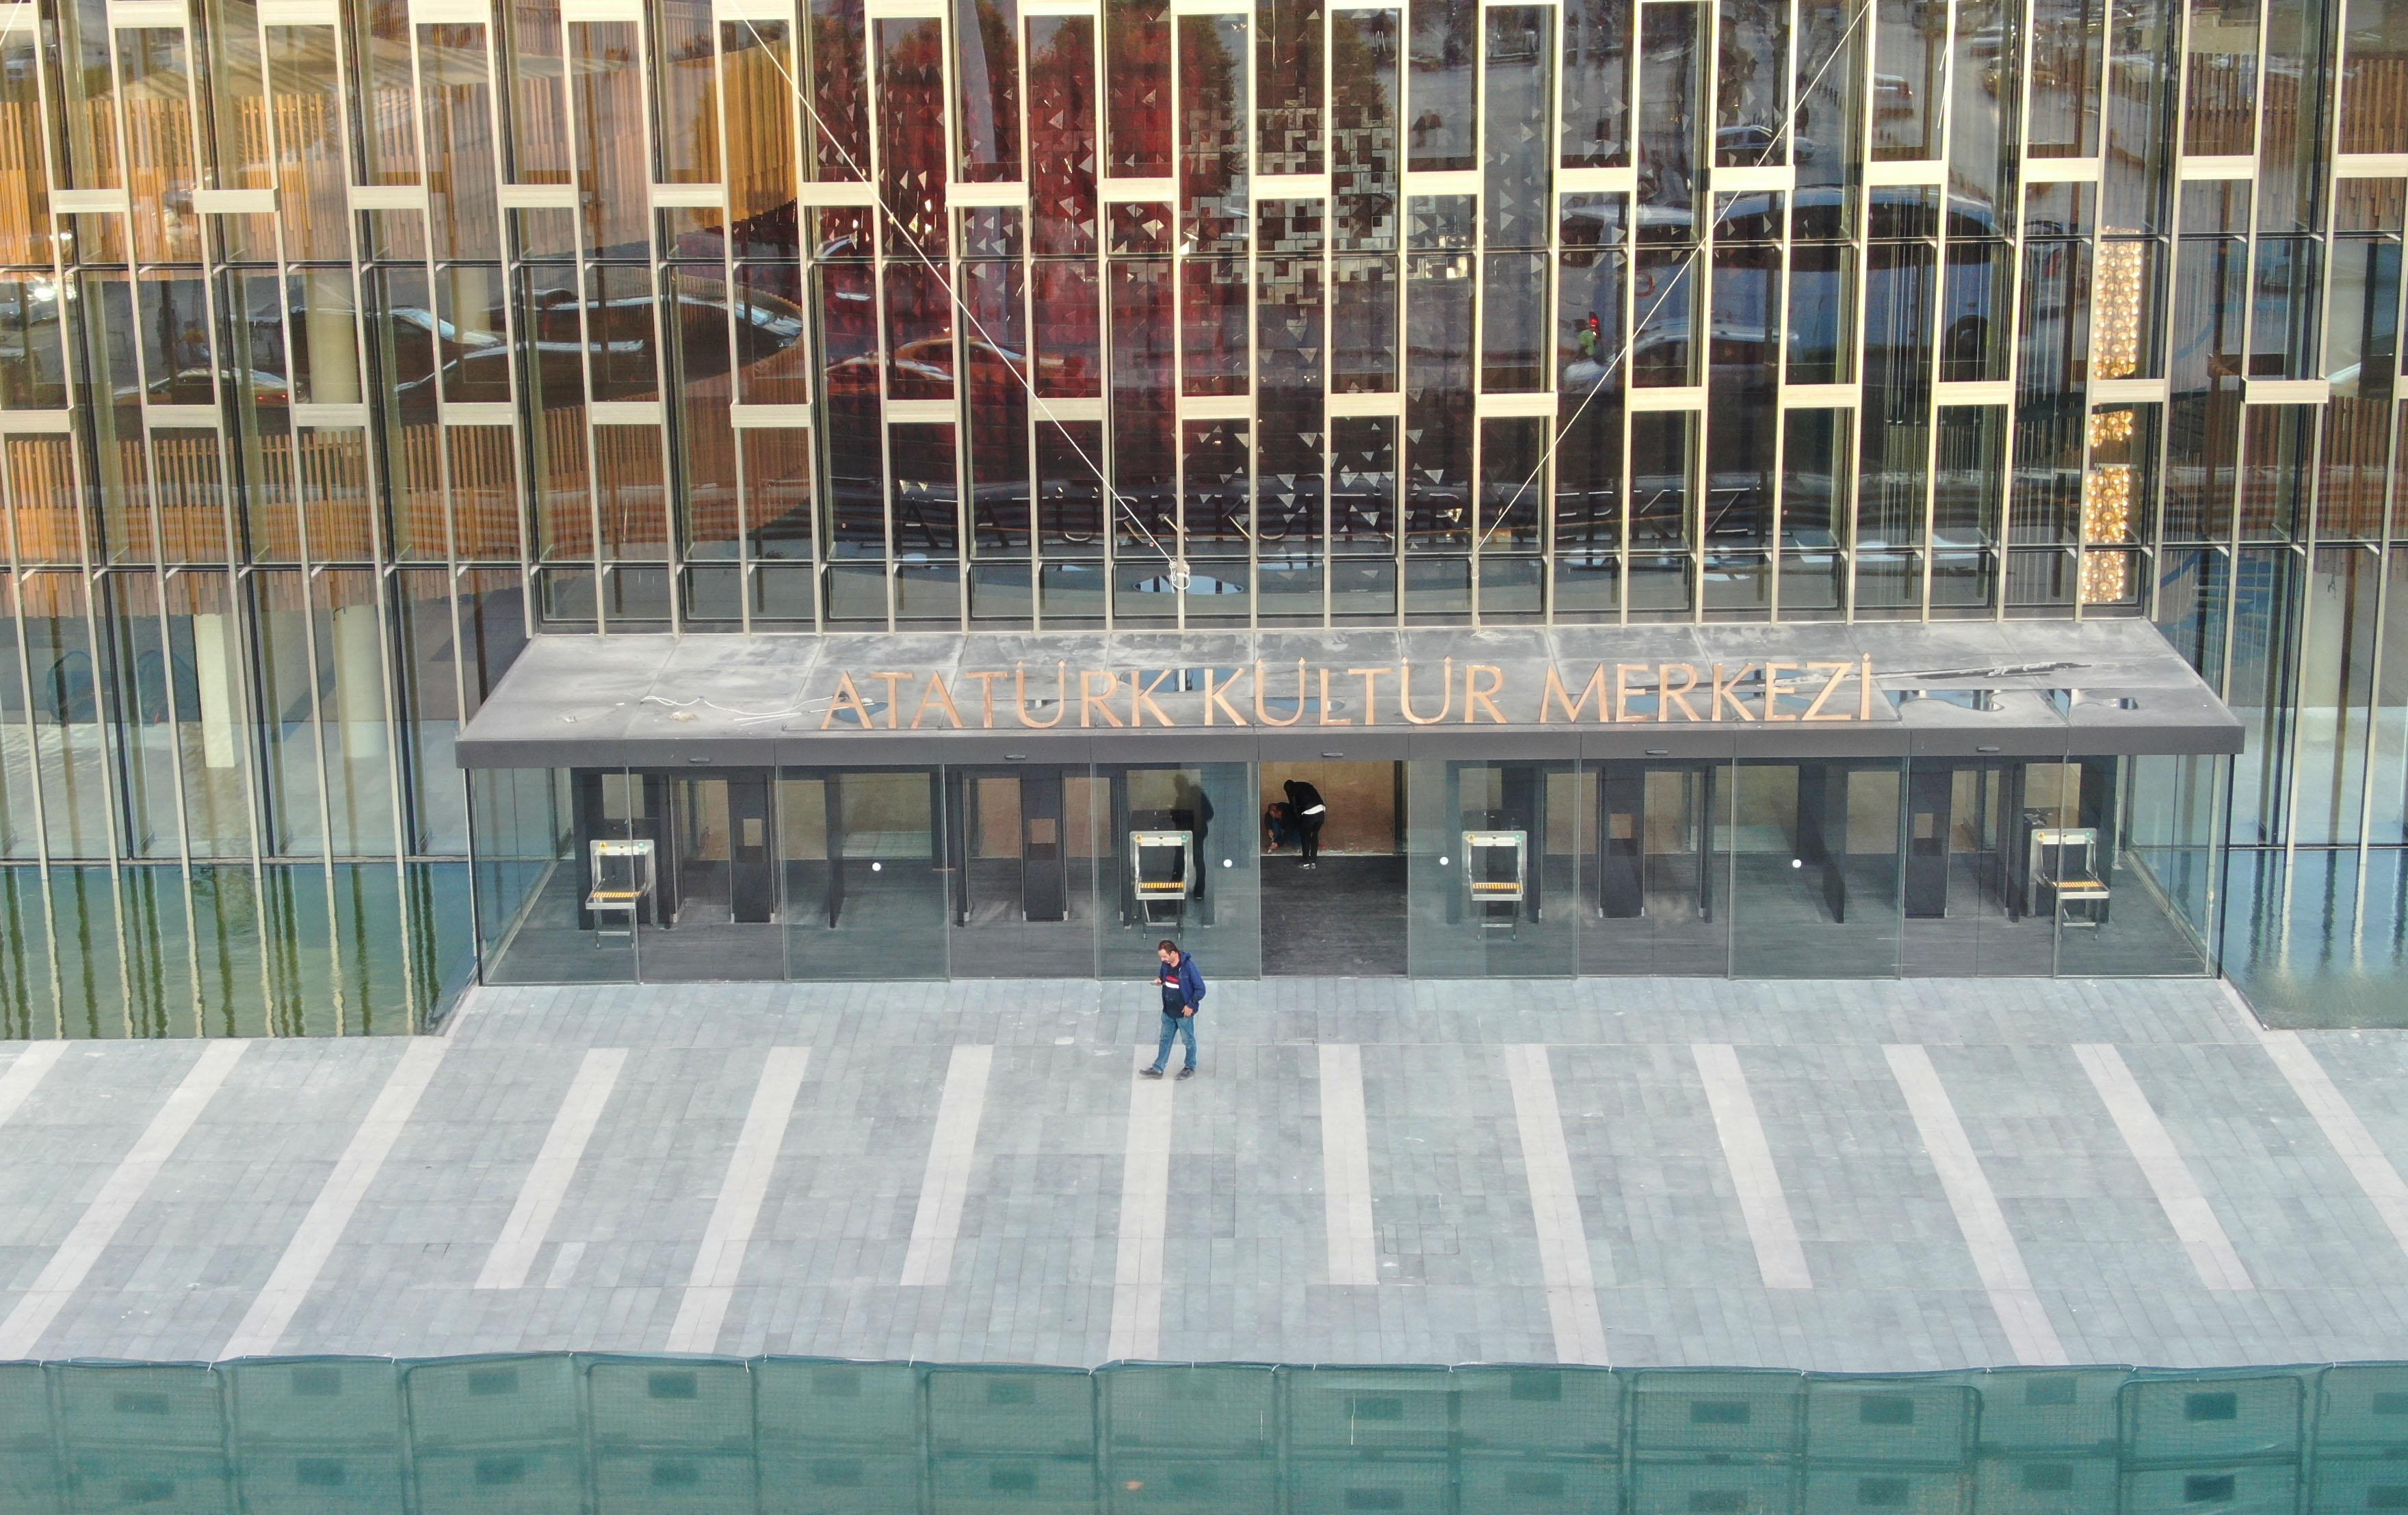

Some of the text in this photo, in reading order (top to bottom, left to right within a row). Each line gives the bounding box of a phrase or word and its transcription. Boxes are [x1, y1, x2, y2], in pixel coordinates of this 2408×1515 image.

[821, 652, 1872, 729] ATATÜRK KÜLTÜR MERKEZİ
